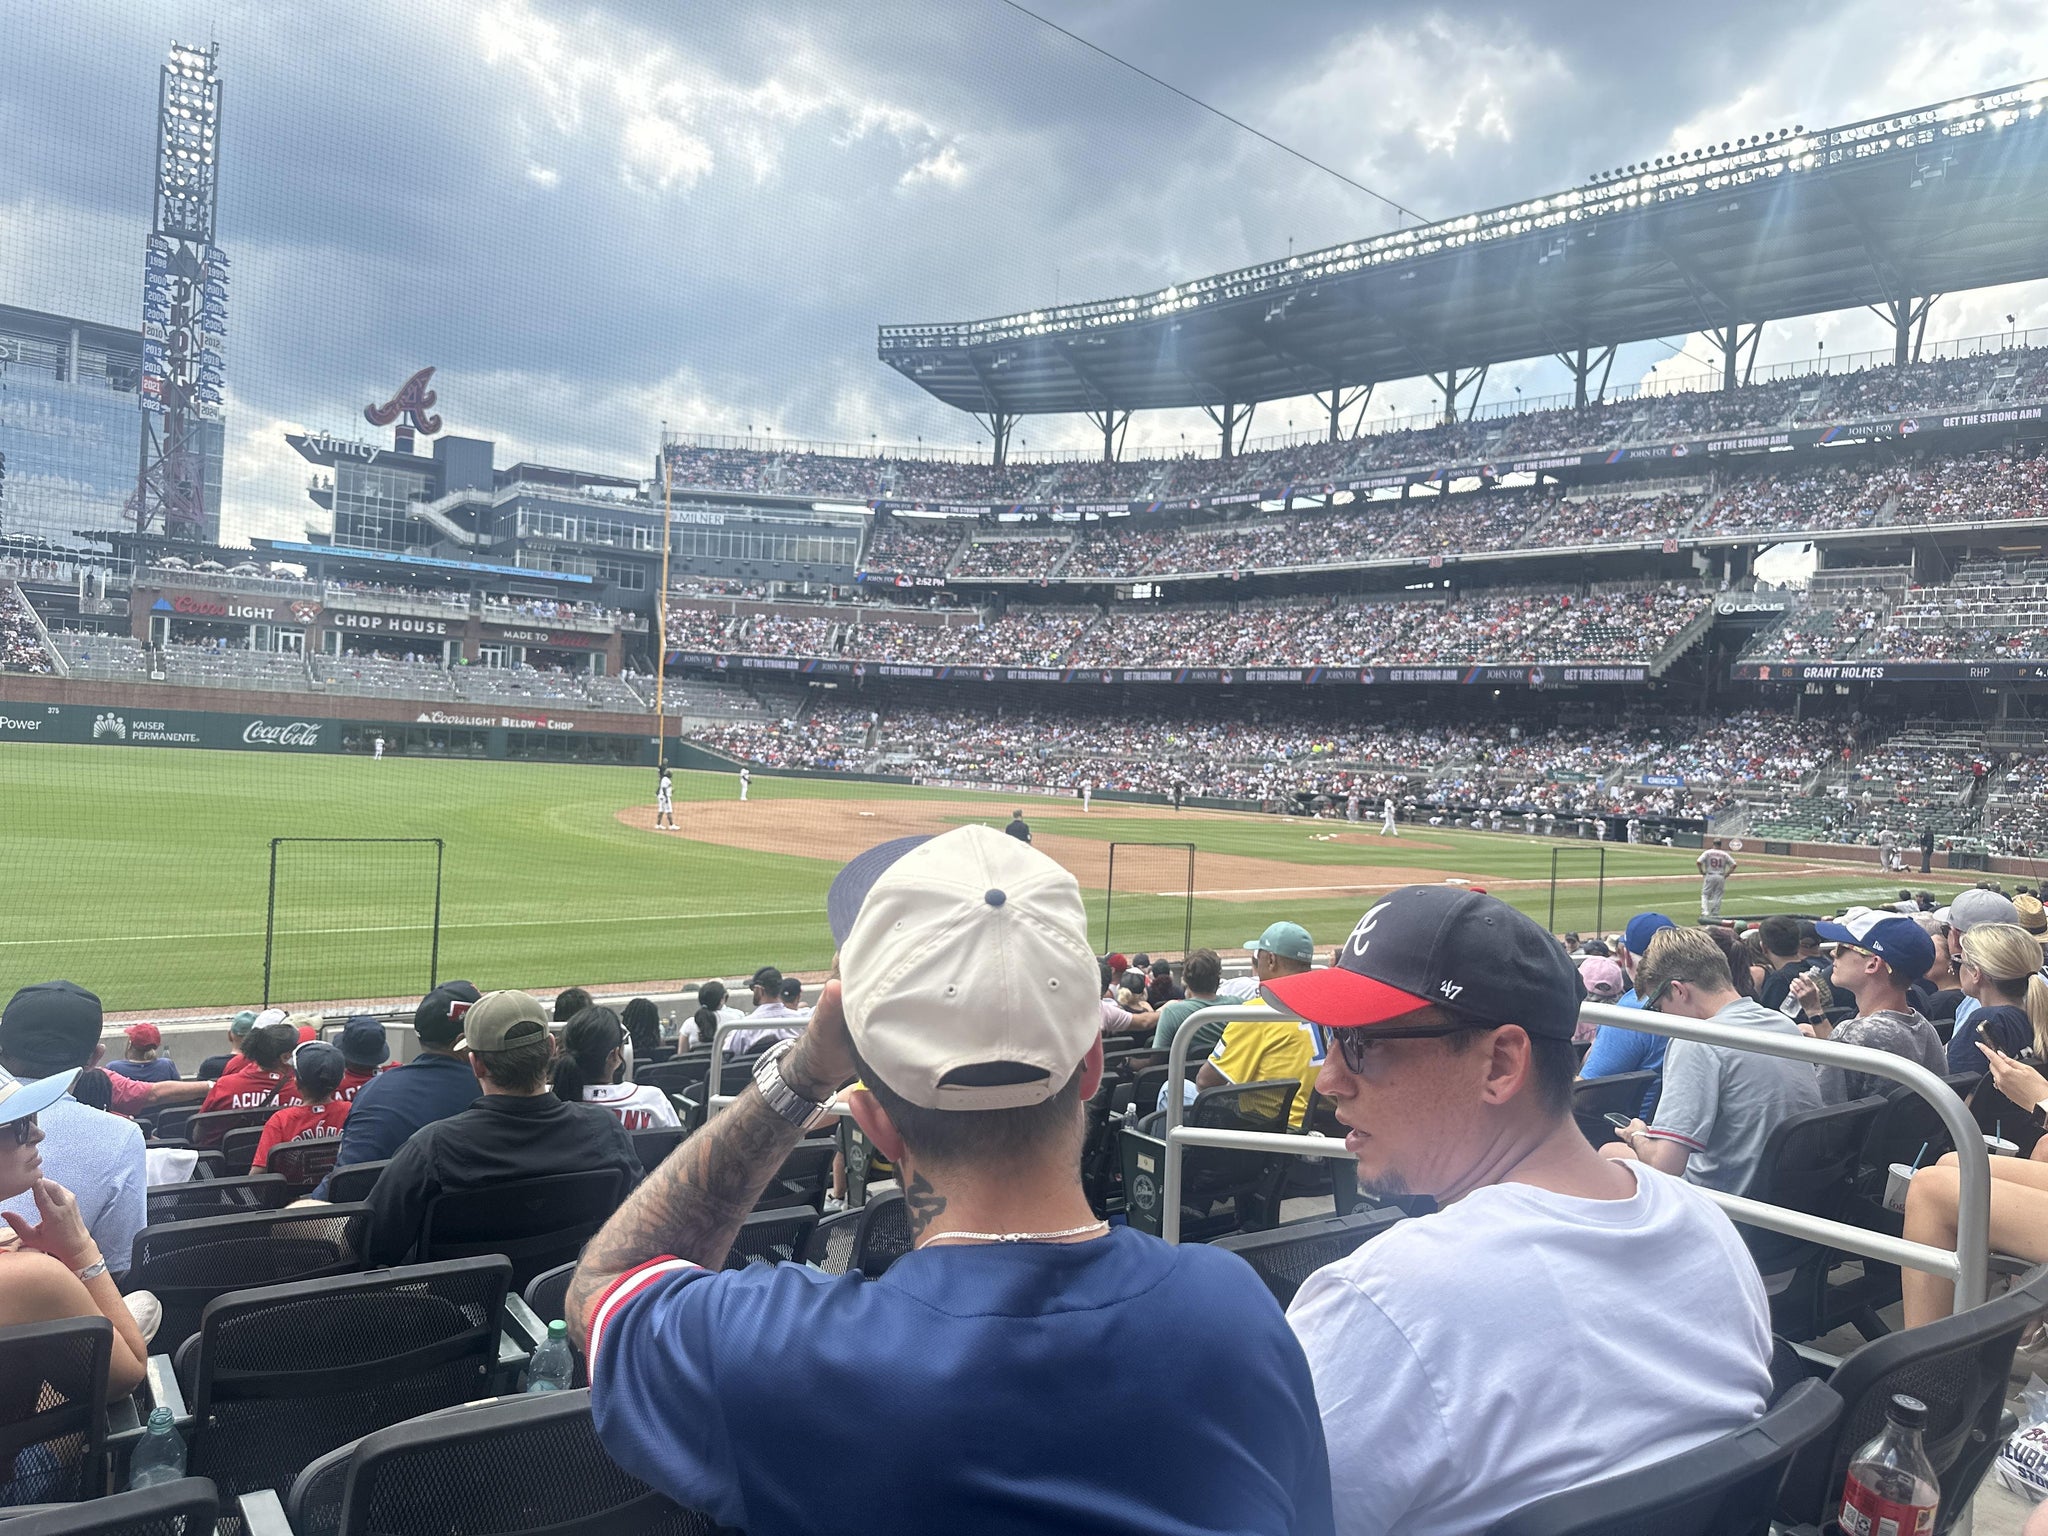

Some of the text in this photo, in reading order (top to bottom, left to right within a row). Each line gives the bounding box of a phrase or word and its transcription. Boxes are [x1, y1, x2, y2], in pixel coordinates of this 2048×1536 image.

[146, 326, 164, 339] 2010
[204, 336, 221, 349] 2012
[145, 344, 163, 356] 2013
[143, 379, 161, 392] 2021
[201, 389, 219, 401] 2022
[142, 398, 160, 411] 2023
[201, 406, 218, 418] 2024
[1943, 408, 2042, 428] GET THE STRONG ARM
[1847, 424, 1894, 437] JOHN FOY
[302, 430, 382, 464] xfinity
[1707, 435, 1788, 451] GET THE STRONG ARM
[1630, 448, 1667, 458] JOHN FOY
[680, 512, 723, 525] MILNER
[915, 577, 945, 587] 2:52 PM
[174, 596, 275, 620] Coors LIGHT
[1736, 602, 1785, 612] LEXUS
[334, 613, 447, 635] CHOP HOUSE
[503, 630, 533, 641] MADE
[536, 633, 549, 642] TO
[1390, 669, 1458, 681] GET THE STRONG ARM
[1486, 670, 1524, 680] JOHN FOY
[1563, 669, 1644, 681] GET THE STRONG ARM
[1782, 668, 1793, 677] 66
[1803, 667, 1885, 679] GRANT HOLMES
[1970, 667, 1990, 677] RHP
[0, 716, 42, 730] Power
[431, 711, 496, 727] Coors LIGHT
[501, 717, 536, 728] BELOW
[548, 719, 574, 730] CHOP
[132, 720, 165, 731] KAISER
[132, 731, 197, 743] PERMANENTE
[1647, 777, 1678, 786] GEICO
